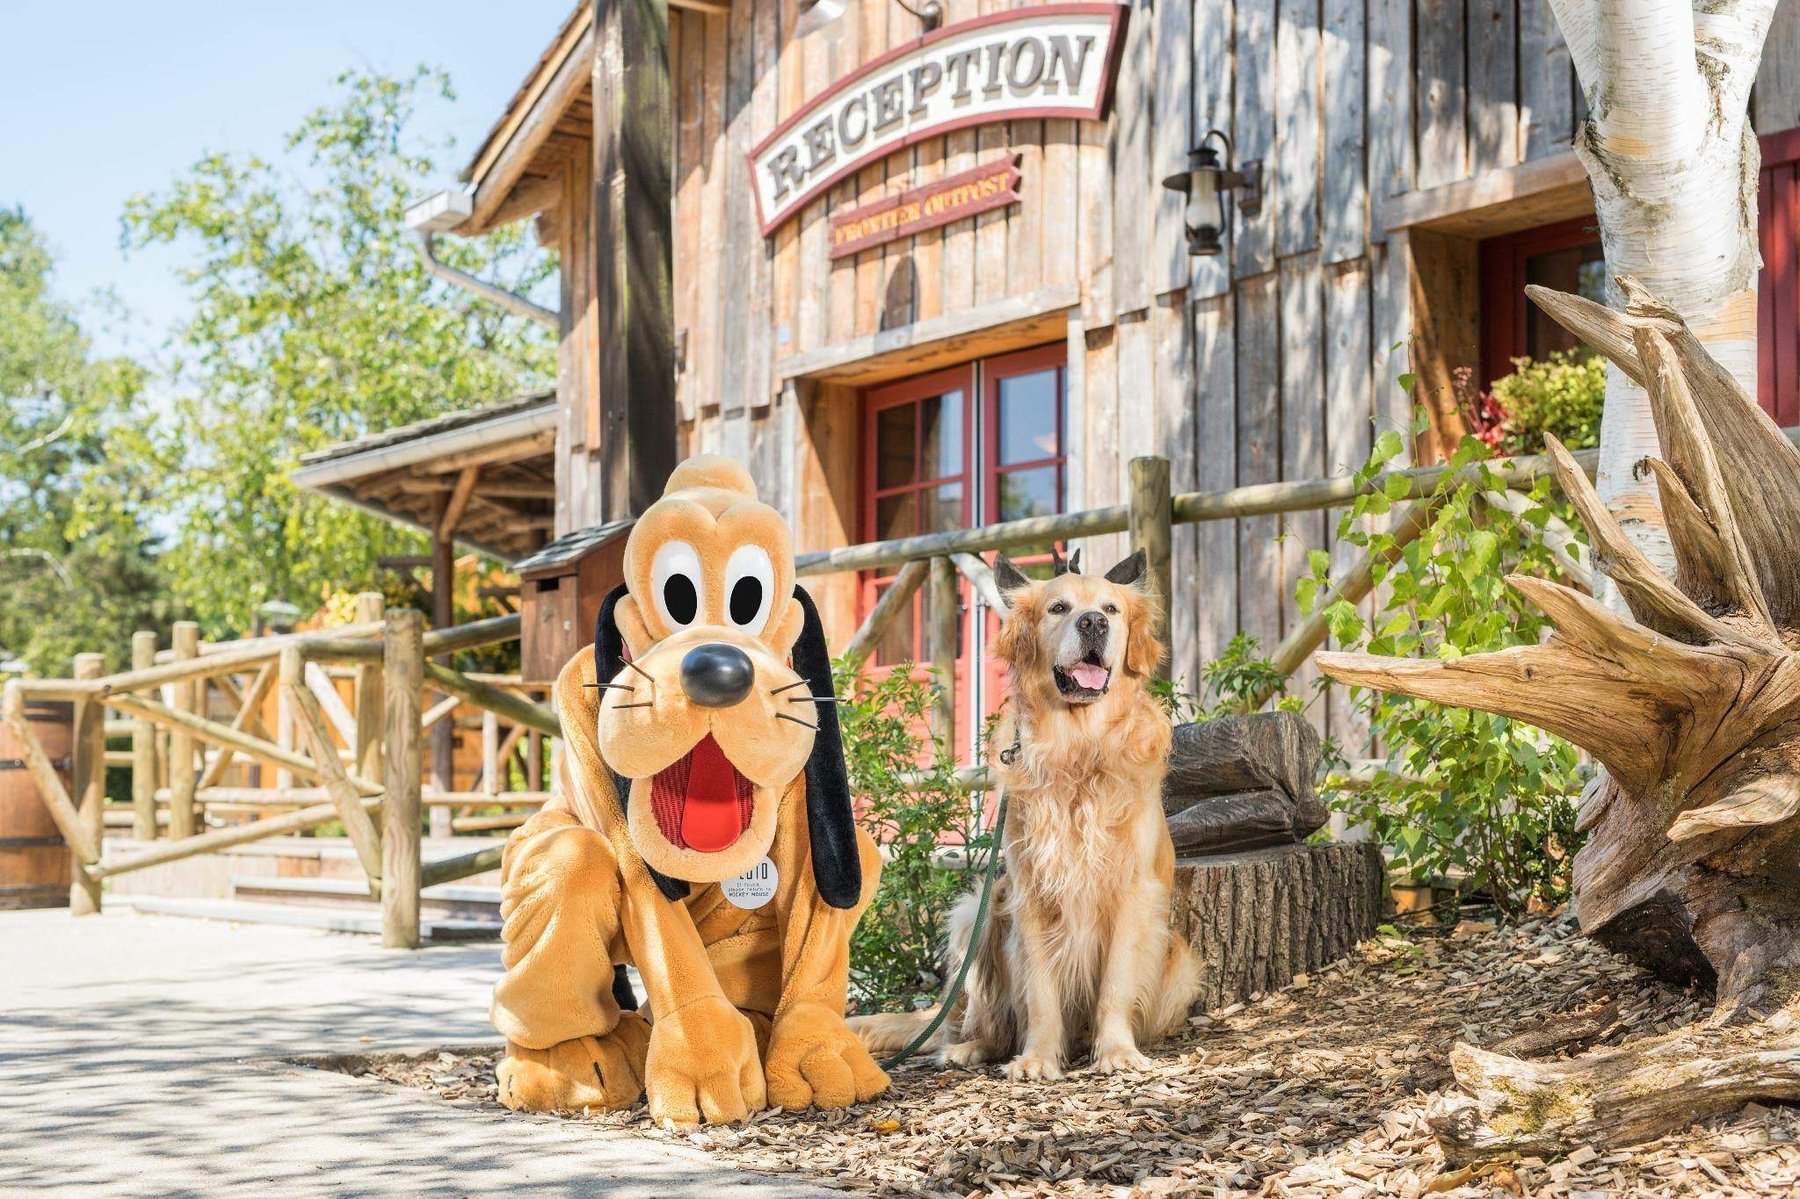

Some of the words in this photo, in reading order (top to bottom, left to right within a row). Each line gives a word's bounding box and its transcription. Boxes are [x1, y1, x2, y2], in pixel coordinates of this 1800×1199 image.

[767, 35, 1095, 200] RECEPTION
[834, 202, 921, 246] FRONTIER
[923, 172, 1010, 217] OUTPOST
